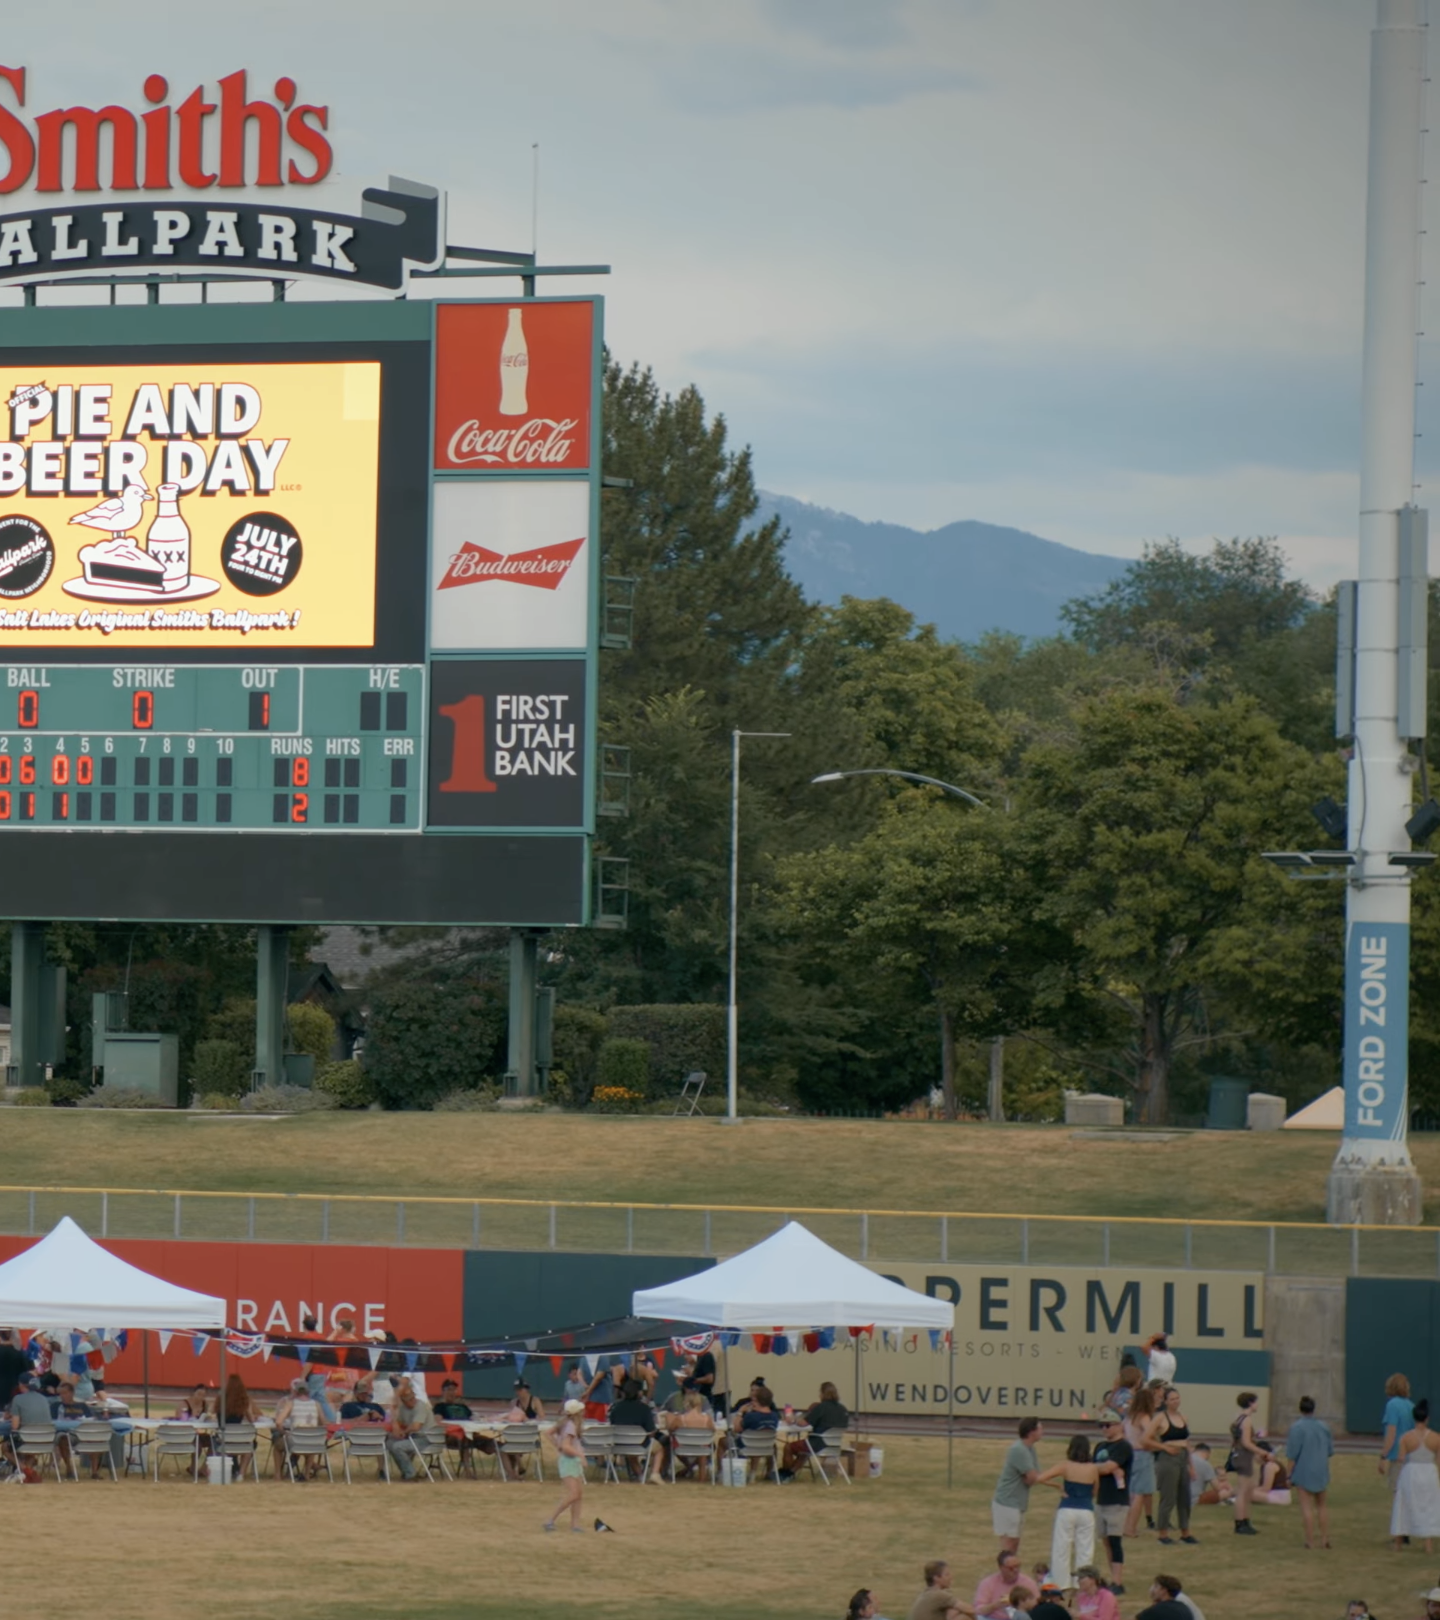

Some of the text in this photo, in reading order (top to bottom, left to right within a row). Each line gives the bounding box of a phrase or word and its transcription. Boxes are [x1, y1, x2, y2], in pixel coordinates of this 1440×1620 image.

[8, 384, 46, 408] OFFICIAL
[12, 382, 262, 438] PIE AND
[447, 418, 579, 464] Coca-Cola
[162, 438, 291, 495] DAY
[236, 522, 298, 557] JULY
[230, 542, 289, 576] 24TH
[448, 551, 572, 578] Budweiser
[28, 609, 76, 629] Lakes
[76, 608, 150, 635] Original
[150, 608, 210, 629] Smiths
[7, 668, 51, 687] BALL
[112, 668, 175, 688] STRIKE
[241, 668, 279, 688] OUT
[369, 668, 400, 690] H/E
[18, 690, 39, 728] 0
[133, 690, 154, 729] 0
[262, 692, 270, 726] 1
[496, 695, 569, 720] FIRST
[0, 737, 8, 753] 2
[23, 737, 32, 753] 3
[56, 737, 65, 753] 4
[81, 737, 90, 753] 5
[104, 737, 114, 753] 6
[139, 737, 148, 753] 7
[163, 737, 171, 753] 8
[187, 737, 195, 753] 9
[216, 738, 234, 754] 10
[271, 738, 414, 755] RUNS HITS ERR
[438, 694, 498, 792] 1
[496, 723, 575, 748] UTAH
[19, 755, 35, 785] 6
[52, 754, 70, 785] 0
[76, 755, 93, 785] 0
[292, 757, 309, 787] 8
[494, 751, 577, 776] BANK
[28, 792, 35, 818] 1
[61, 792, 68, 818] 1
[291, 793, 308, 823] 2
[1357, 936, 1387, 1127] FORD ZONE
[878, 1274, 1263, 1338] PERMILL
